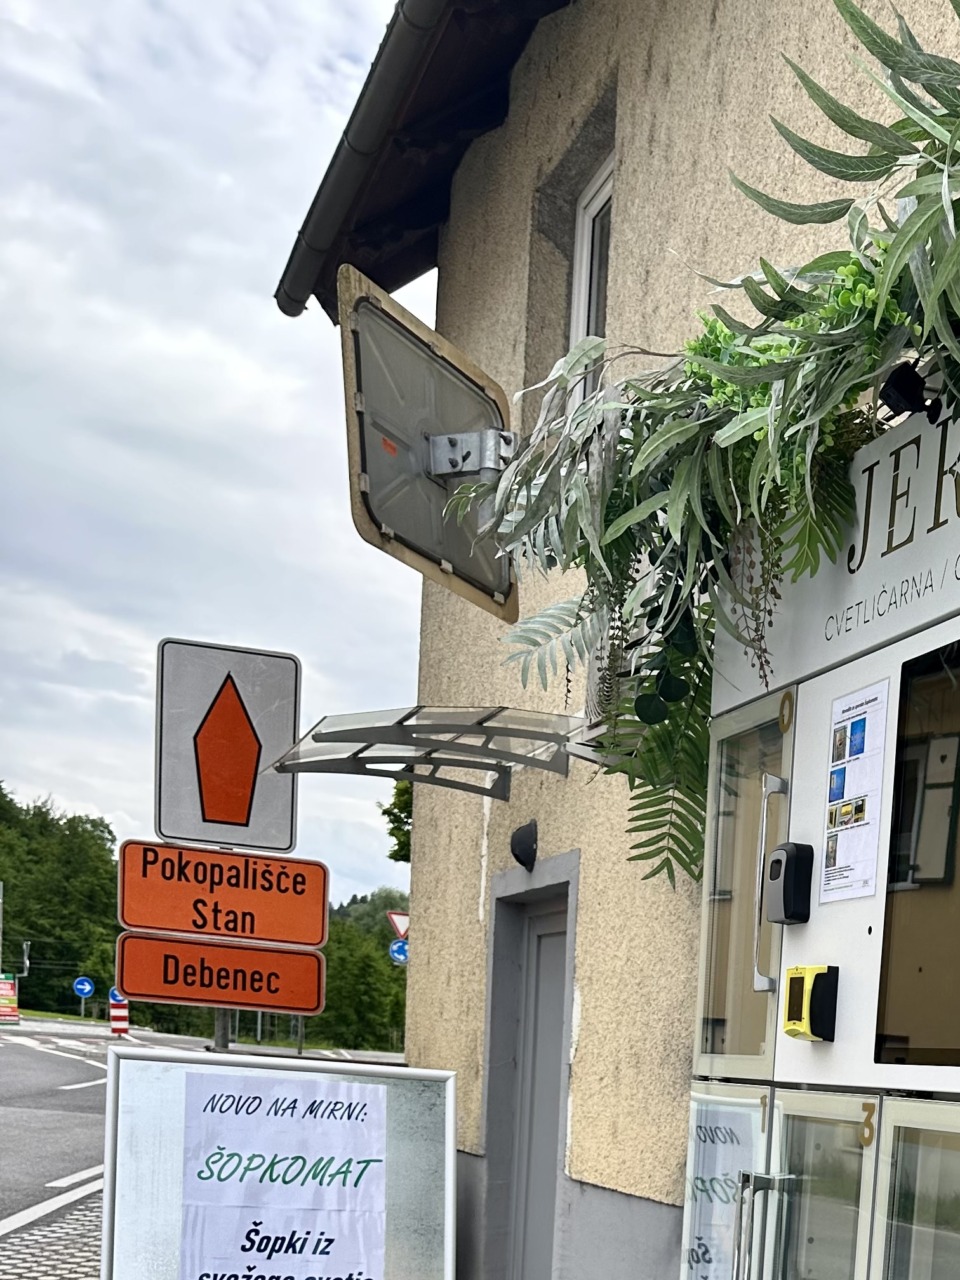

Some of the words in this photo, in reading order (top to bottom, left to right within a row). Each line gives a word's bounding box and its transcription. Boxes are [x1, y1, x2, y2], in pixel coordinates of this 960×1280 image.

[824, 568, 934, 642] CVETLIČARNA
[141, 846, 307, 898] Pokopališče
[191, 897, 256, 935] Stan
[162, 953, 281, 995] Debenec
[202, 1093, 262, 1117] NOVO
[266, 1096, 299, 1119] NA
[301, 1098, 368, 1124] MIRNI:
[858, 1102, 876, 1147] 3
[196, 1144, 383, 1190] ŠOPKOMAT
[239, 1219, 310, 1261] Šopki
[311, 1231, 336, 1256] iz
